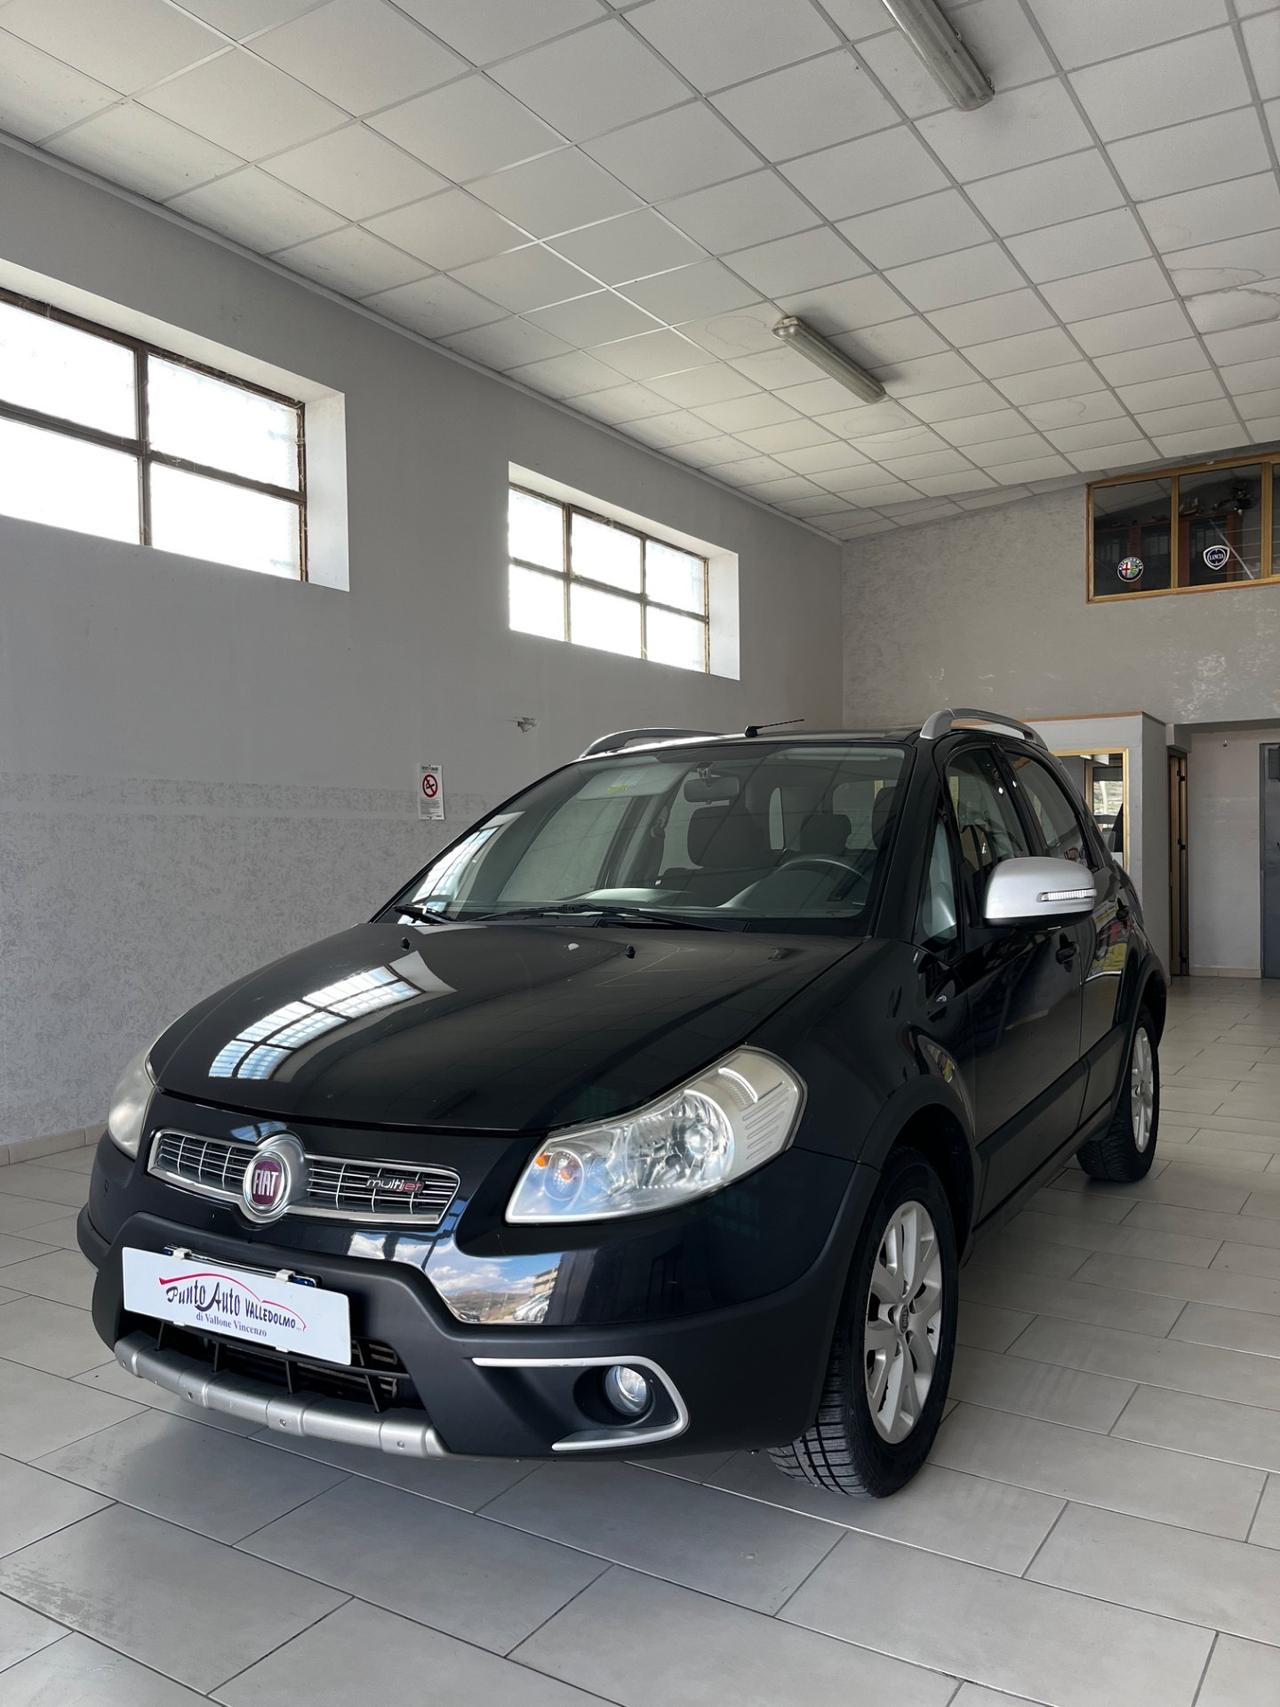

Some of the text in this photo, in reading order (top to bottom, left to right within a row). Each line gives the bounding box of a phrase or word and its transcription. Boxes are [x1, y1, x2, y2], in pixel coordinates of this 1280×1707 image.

[253, 1169, 279, 1197] FIAT
[366, 1178, 422, 1192] multijet
[166, 1280, 296, 1329] Punto Auto VALLEDOLMO
[196, 1312, 267, 1337] di Vallone Vincenzo
